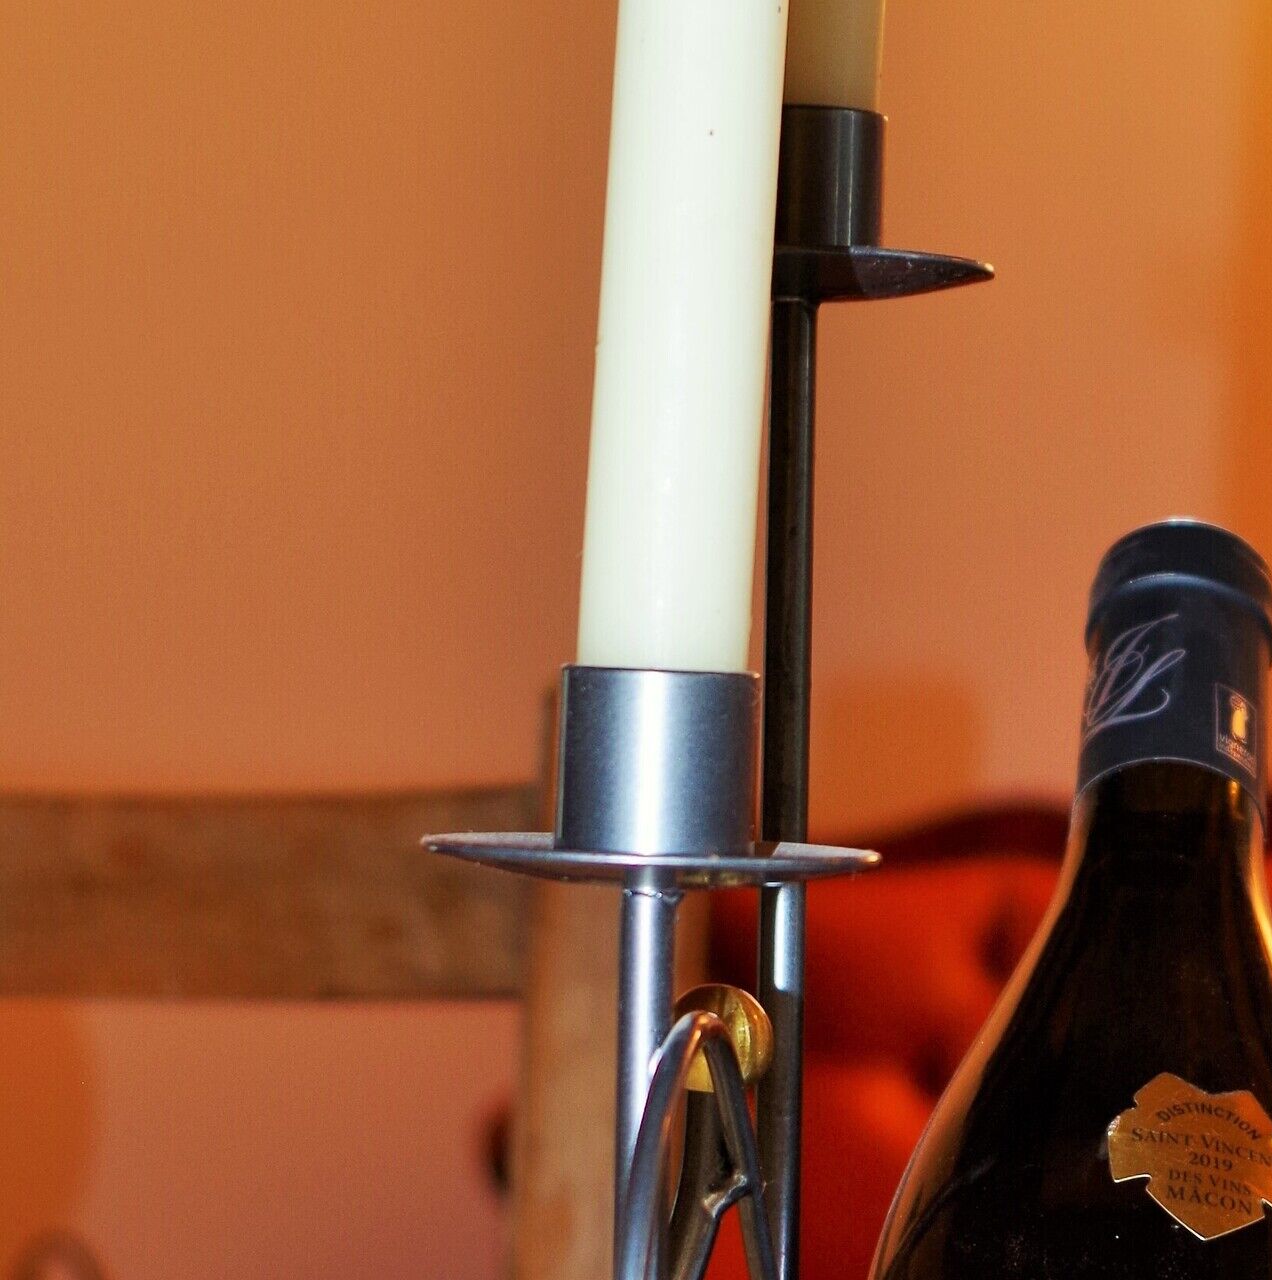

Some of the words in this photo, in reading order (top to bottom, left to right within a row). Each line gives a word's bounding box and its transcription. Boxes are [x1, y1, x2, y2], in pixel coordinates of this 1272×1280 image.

[1157, 1102, 1262, 1141] DISTINCTION
[1131, 1126, 1196, 1147] SAINT
[1188, 1152, 1233, 1171] 2019
